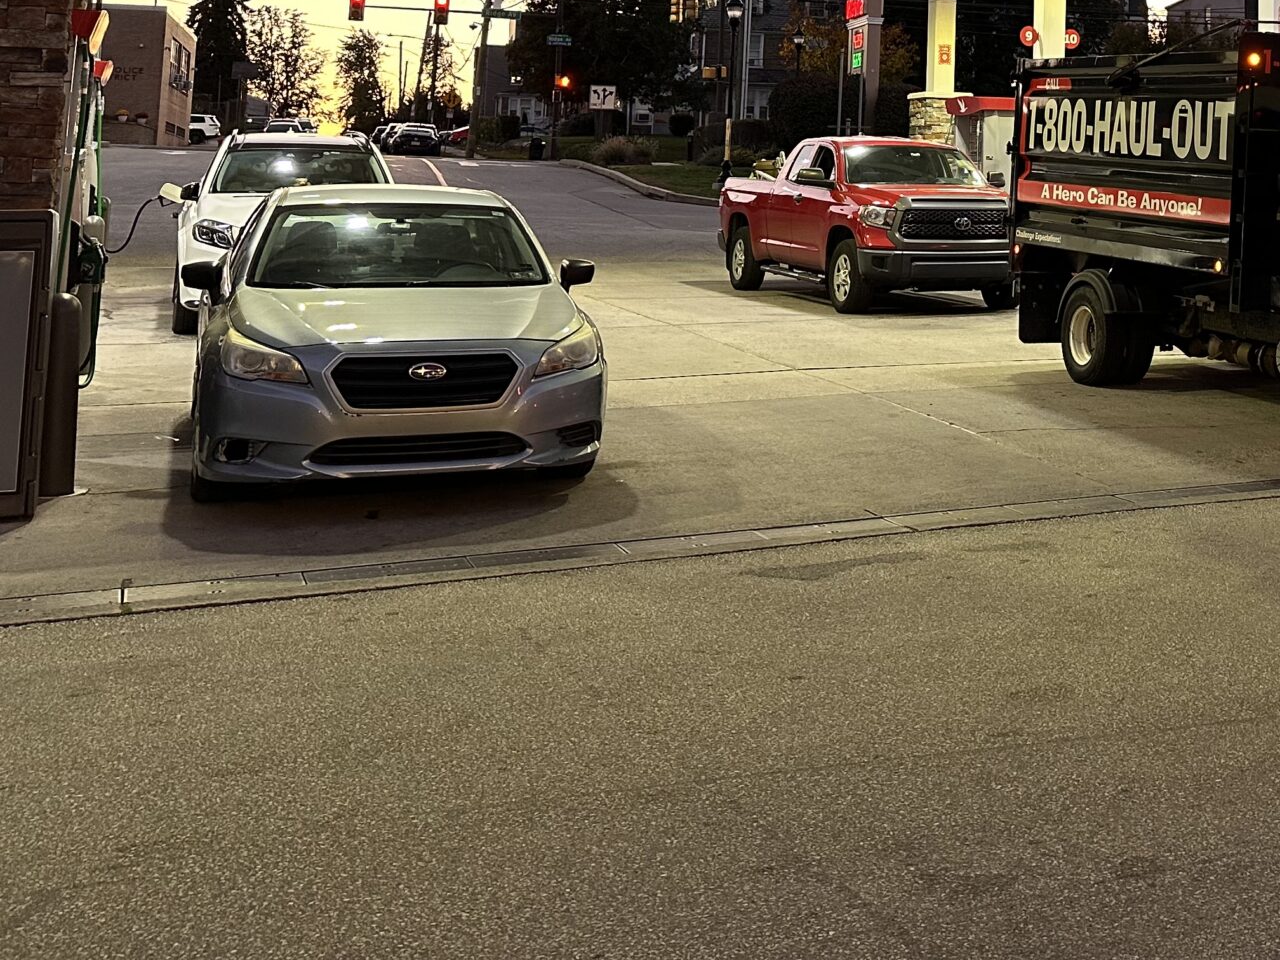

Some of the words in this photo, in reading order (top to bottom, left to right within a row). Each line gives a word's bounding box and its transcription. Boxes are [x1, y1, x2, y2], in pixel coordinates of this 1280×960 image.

[1025, 31, 1033, 42] 9
[1065, 34, 1078, 45] 10
[115, 66, 144, 75] OLICE
[1045, 78, 1060, 90] CALL
[1028, 98, 1236, 161] 1-800-HAUL-OUT
[1041, 184, 1050, 200] A
[1052, 185, 1085, 203] Hero
[1087, 187, 1114, 207] Can
[1117, 190, 1137, 209] Be
[1140, 193, 1203, 217] Anyone!
